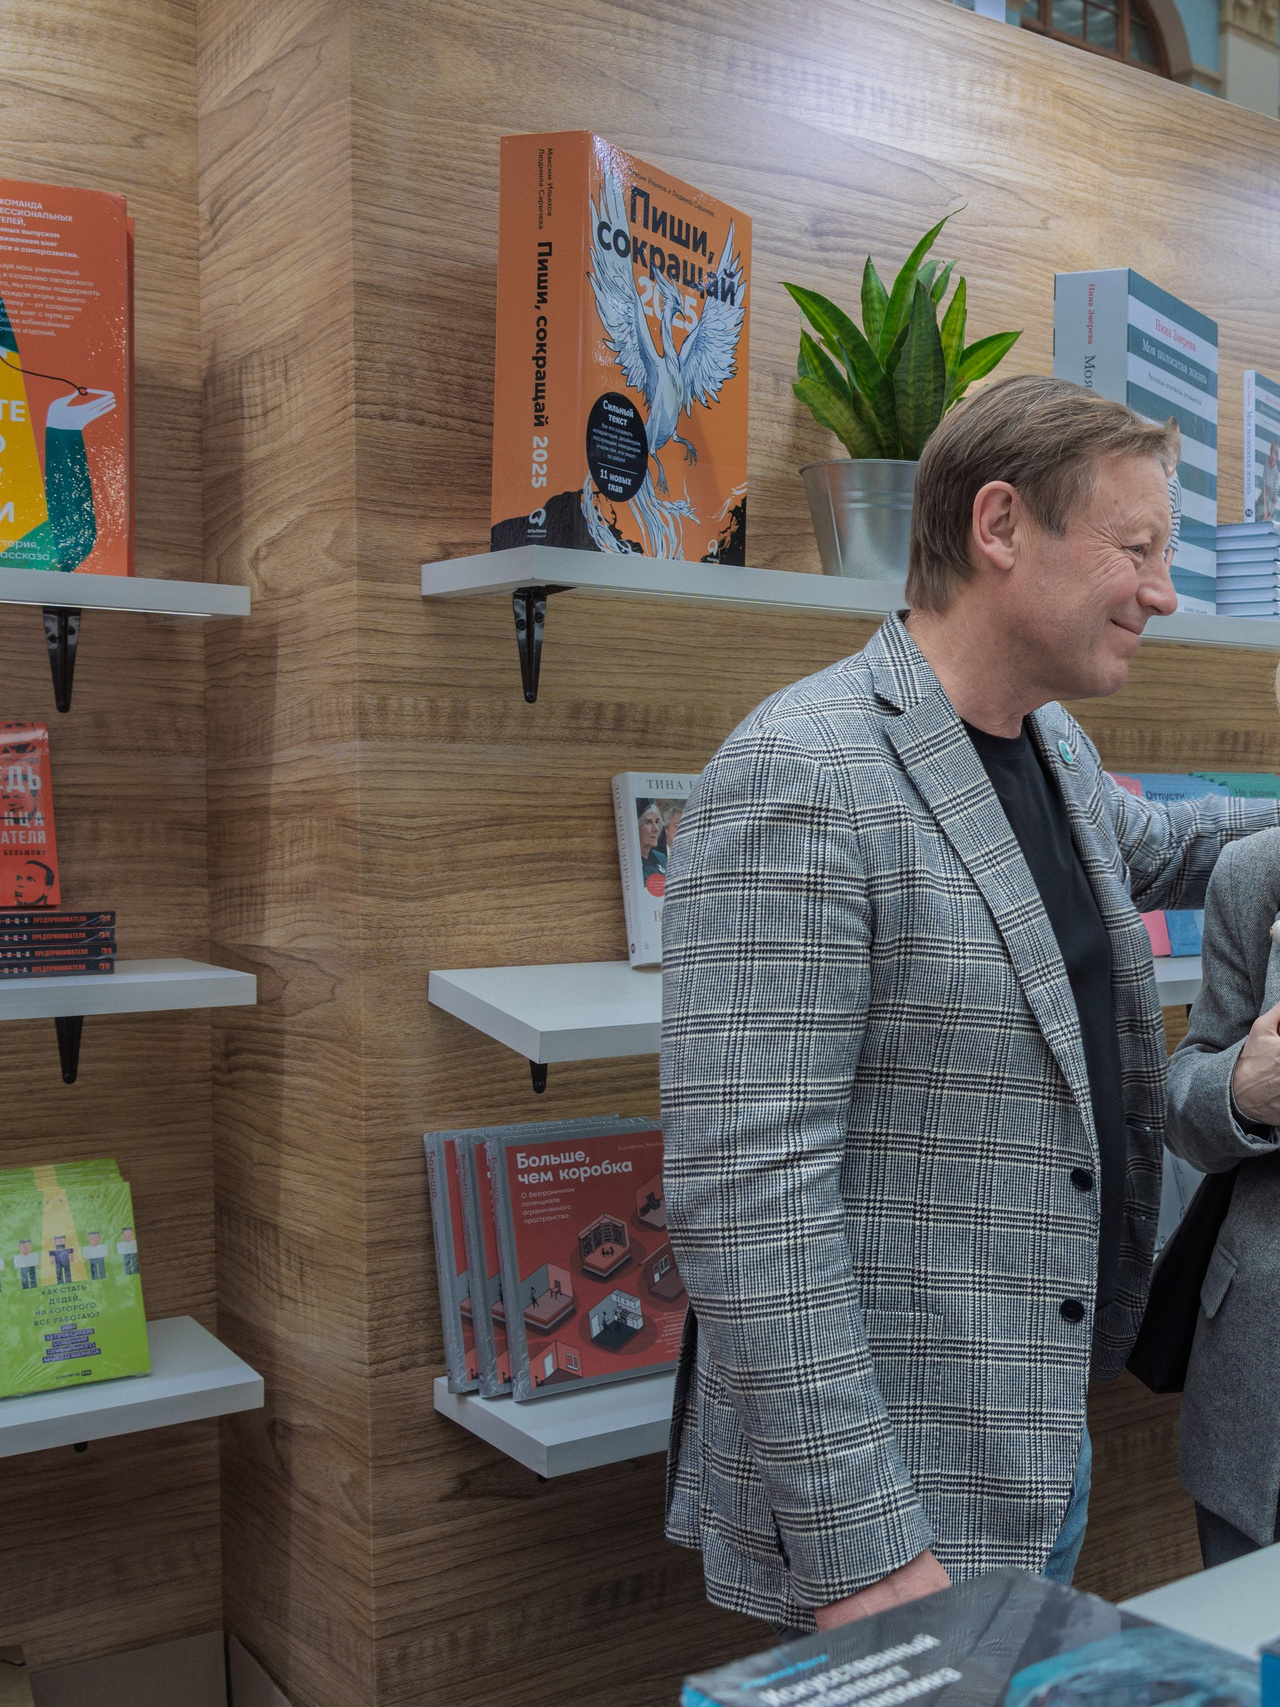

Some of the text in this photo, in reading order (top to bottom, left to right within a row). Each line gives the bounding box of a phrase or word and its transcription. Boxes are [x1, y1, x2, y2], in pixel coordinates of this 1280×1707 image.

[630, 184, 715, 265] Пиши,
[597, 220, 736, 307] сокращай
[637, 275, 698, 334] 205
[1155, 318, 1172, 338] Нина
[1142, 338, 1156, 358] Моя
[1157, 349, 1188, 374] полосатая
[531, 241, 553, 489] Пиши, сокращай 2025
[603, 400, 634, 418] Сильный
[608, 414, 628, 427] текст
[599, 468, 632, 487] 11 новых
[608, 483, 624, 494] глав
[646, 779, 684, 790] ТИНА
[1145, 790, 1185, 800] Отпусти
[1235, 787, 1277, 799] Не корми
[516, 1150, 590, 1169] Больше,
[518, 1159, 633, 1185] чем коробка
[528, 1186, 575, 1198] безграничном
[521, 1197, 560, 1208] потенциале
[522, 1204, 572, 1217] ограниченного
[523, 1213, 569, 1225] пространства
[41, 1285, 87, 1297] КАК СТАТЬ
[35, 1302, 97, 1317] НА КОТОРОГО
[34, 1311, 100, 1327] ВСЕ РАБОТАЮТ
